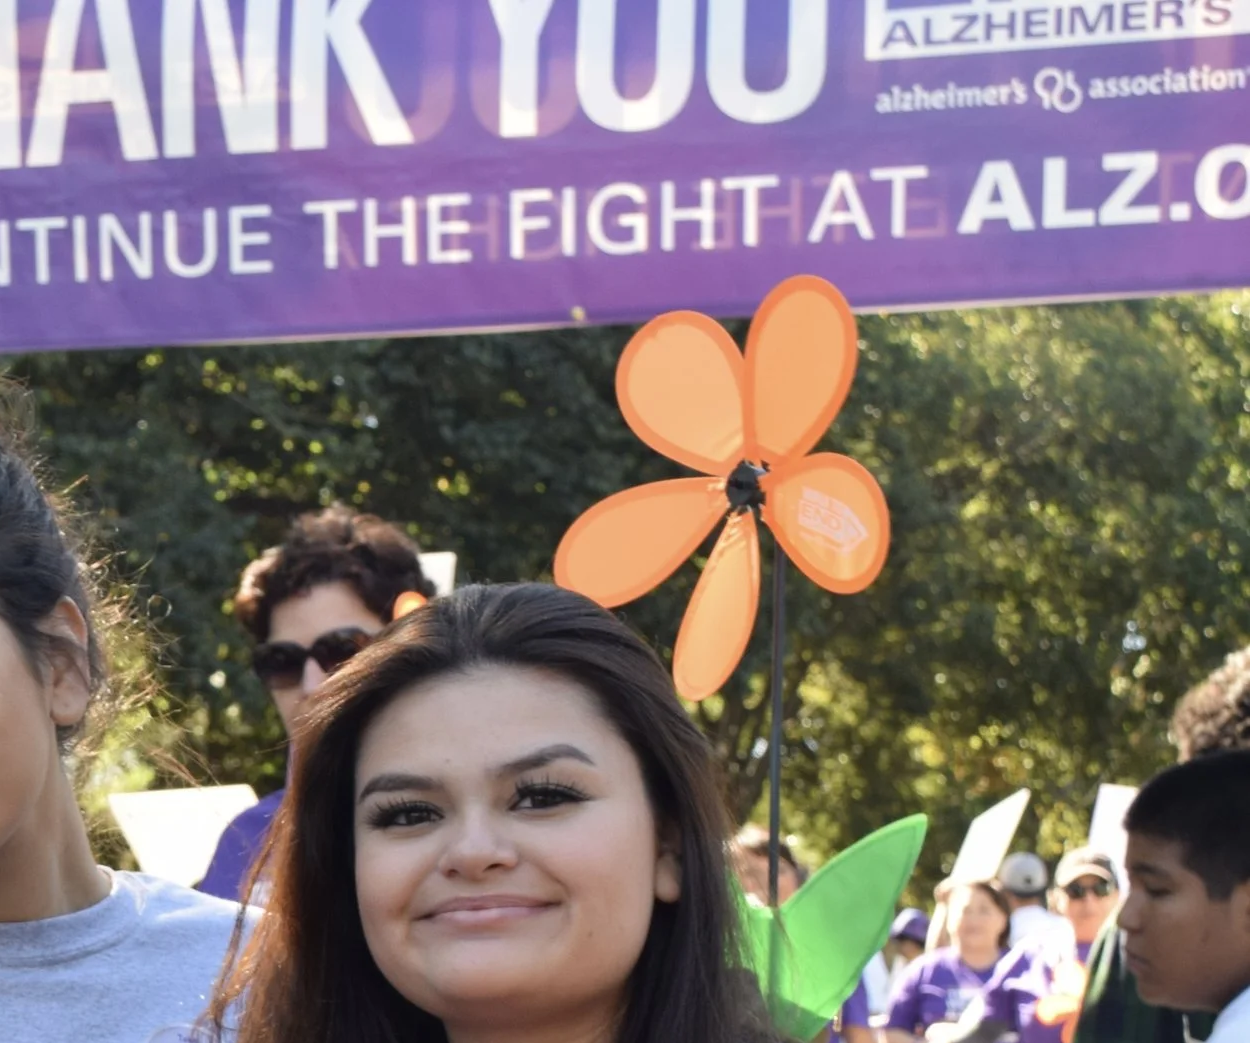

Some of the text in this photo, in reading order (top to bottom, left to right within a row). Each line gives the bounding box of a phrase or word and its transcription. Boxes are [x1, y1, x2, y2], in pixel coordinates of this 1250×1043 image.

[881, 0, 1234, 49] ALZHEIMER'S
[488, 0, 829, 139] YOU
[875, 64, 1246, 113] alzheimer's association
[302, 193, 473, 271] THE
[508, 175, 780, 260] FIGHT
[806, 165, 929, 244] AT
